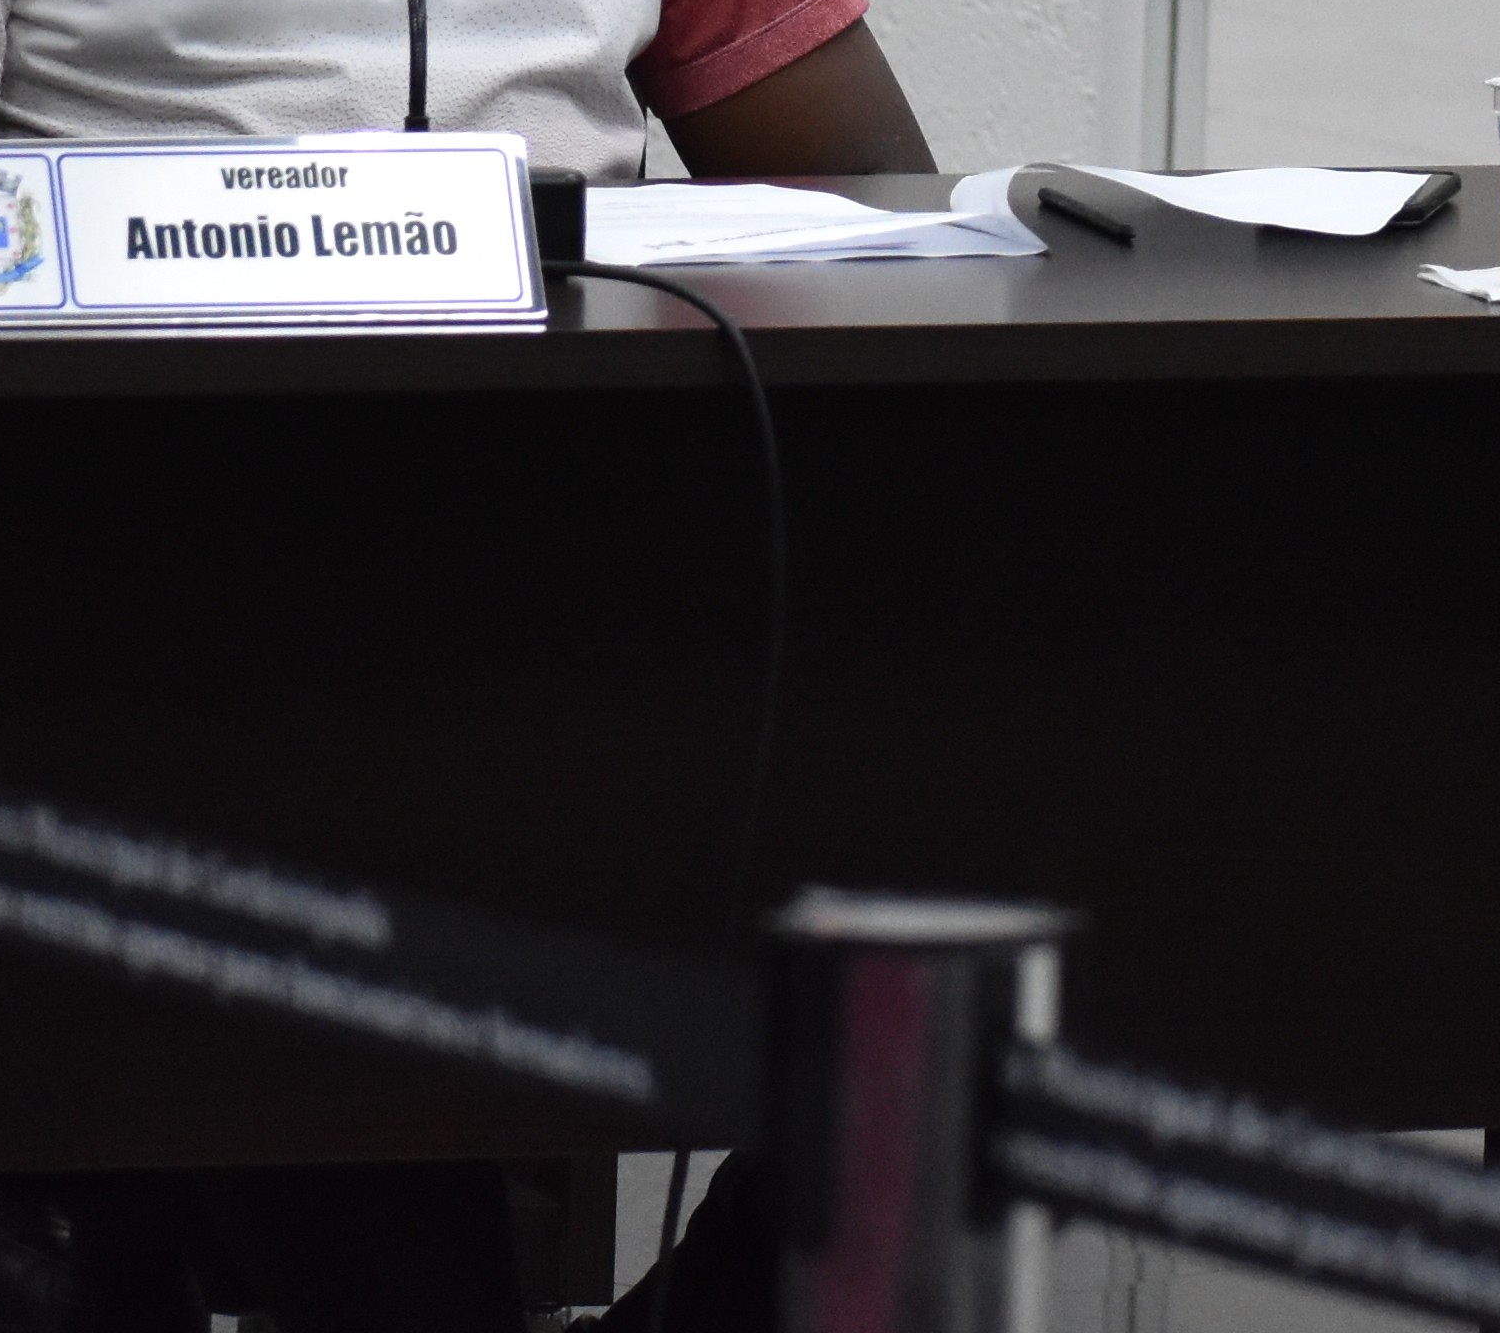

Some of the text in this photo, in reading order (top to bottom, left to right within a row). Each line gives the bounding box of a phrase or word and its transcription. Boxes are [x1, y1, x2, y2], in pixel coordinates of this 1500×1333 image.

[221, 162, 349, 189] vereador
[126, 211, 458, 260] Antonio Lemão
